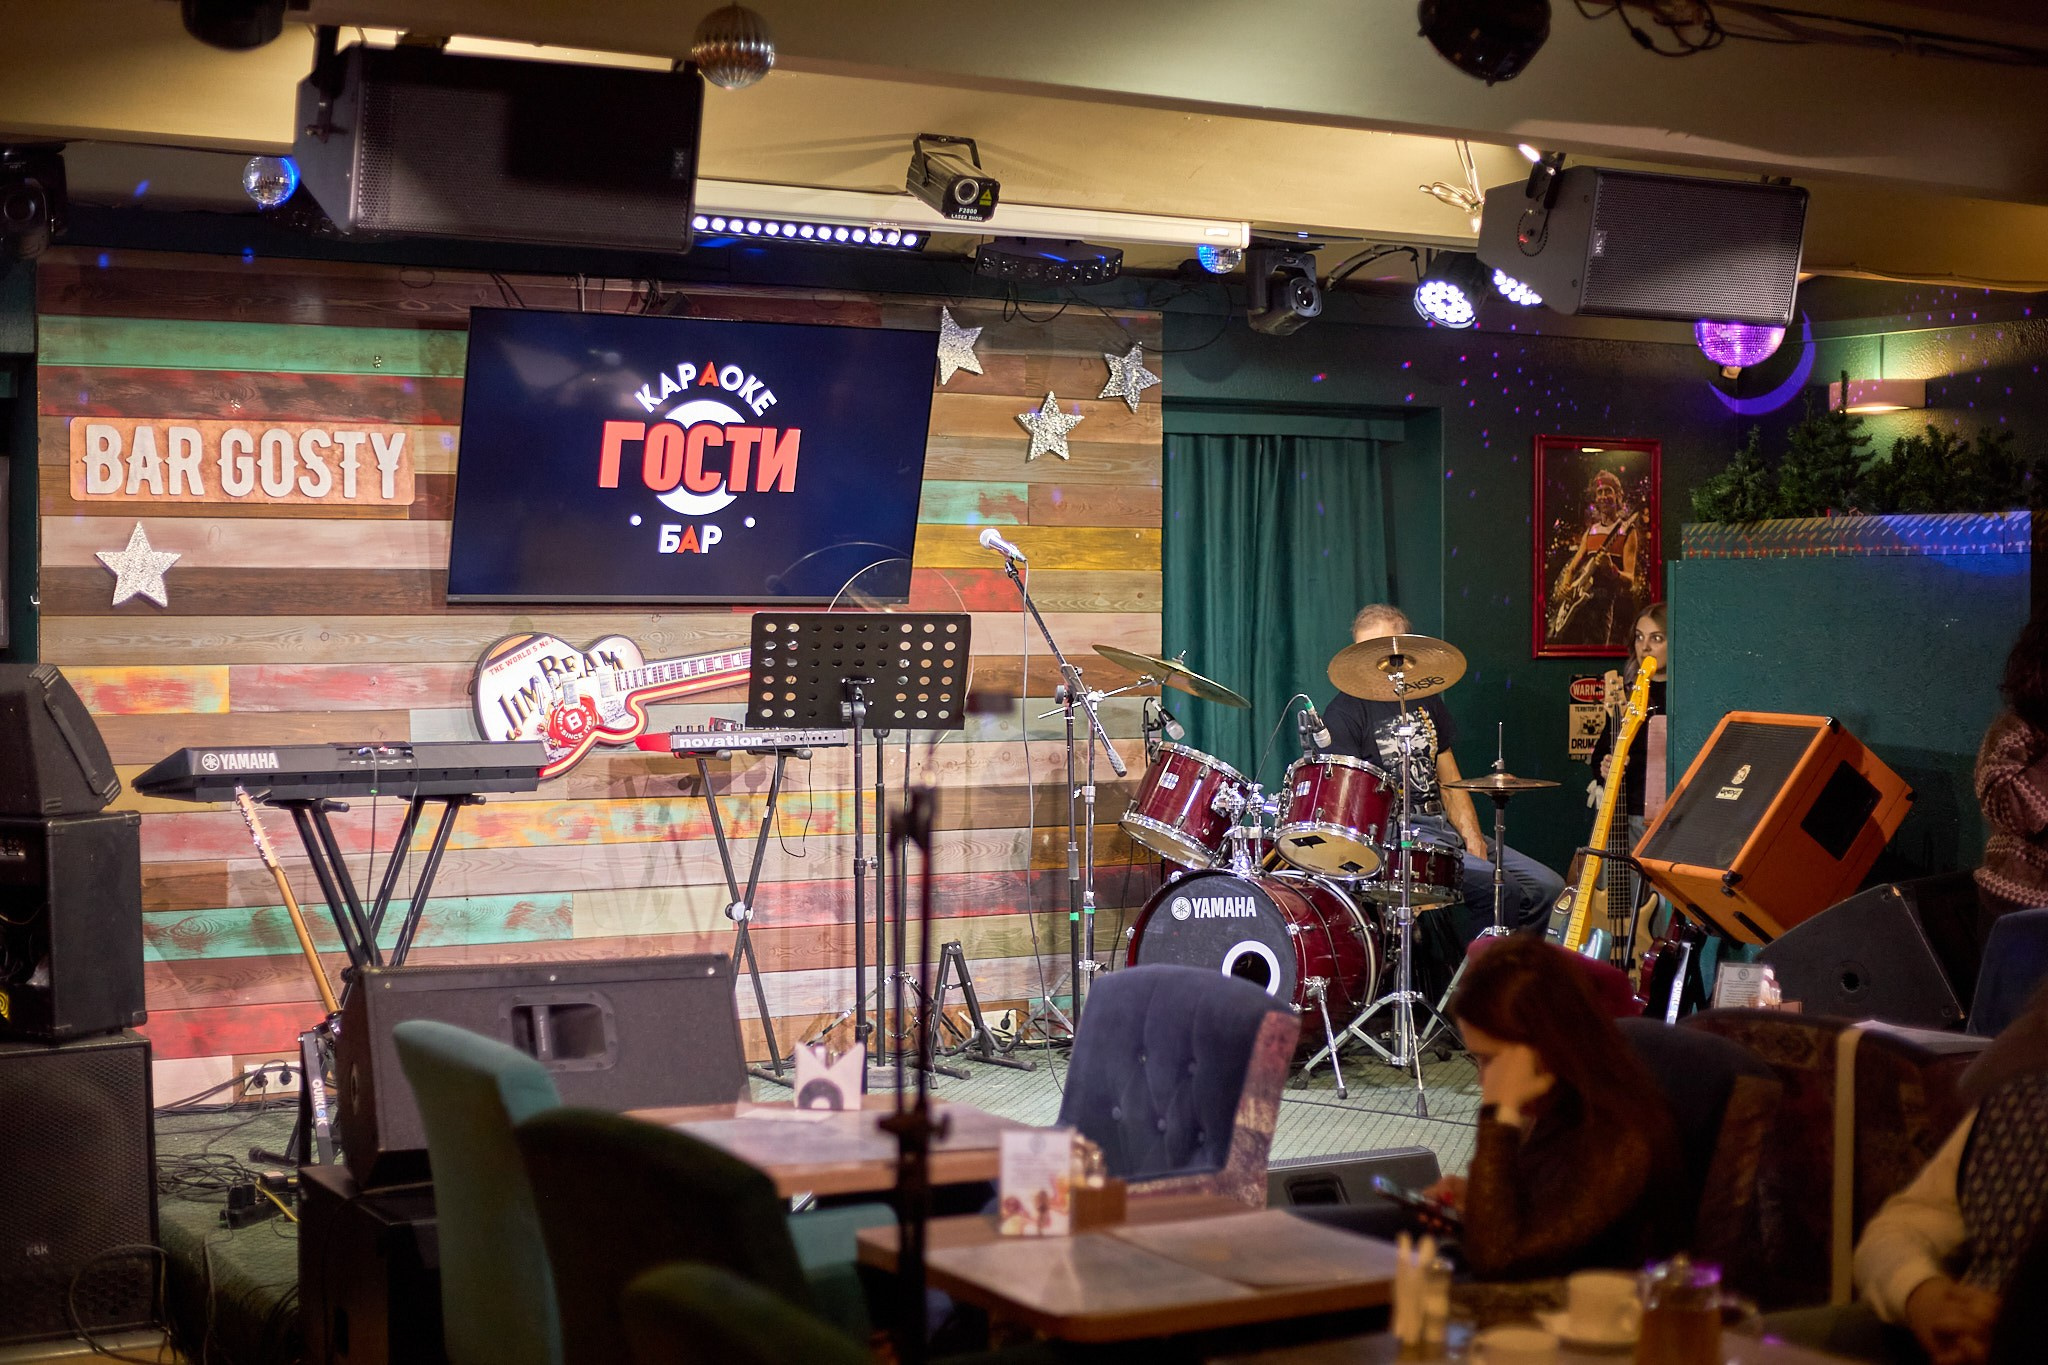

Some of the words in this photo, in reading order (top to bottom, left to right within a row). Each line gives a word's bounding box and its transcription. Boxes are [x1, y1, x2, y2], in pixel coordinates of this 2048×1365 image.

[634, 361, 778, 418] КАРАОКЕ
[82, 424, 205, 495] BAR
[216, 428, 406, 499] GOSTY
[598, 420, 802, 493] ГОСТИ
[658, 523, 723, 554] БАР
[489, 662, 505, 675] THE
[506, 645, 538, 667] WORLDS
[497, 675, 545, 741] JIM
[535, 649, 625, 690] BEAM
[1573, 684, 1604, 696] WARNN
[561, 729, 584, 740] SINCE
[679, 735, 763, 748] novation
[219, 752, 279, 770] YAMAHA
[1192, 896, 1257, 919] YAMAHA
